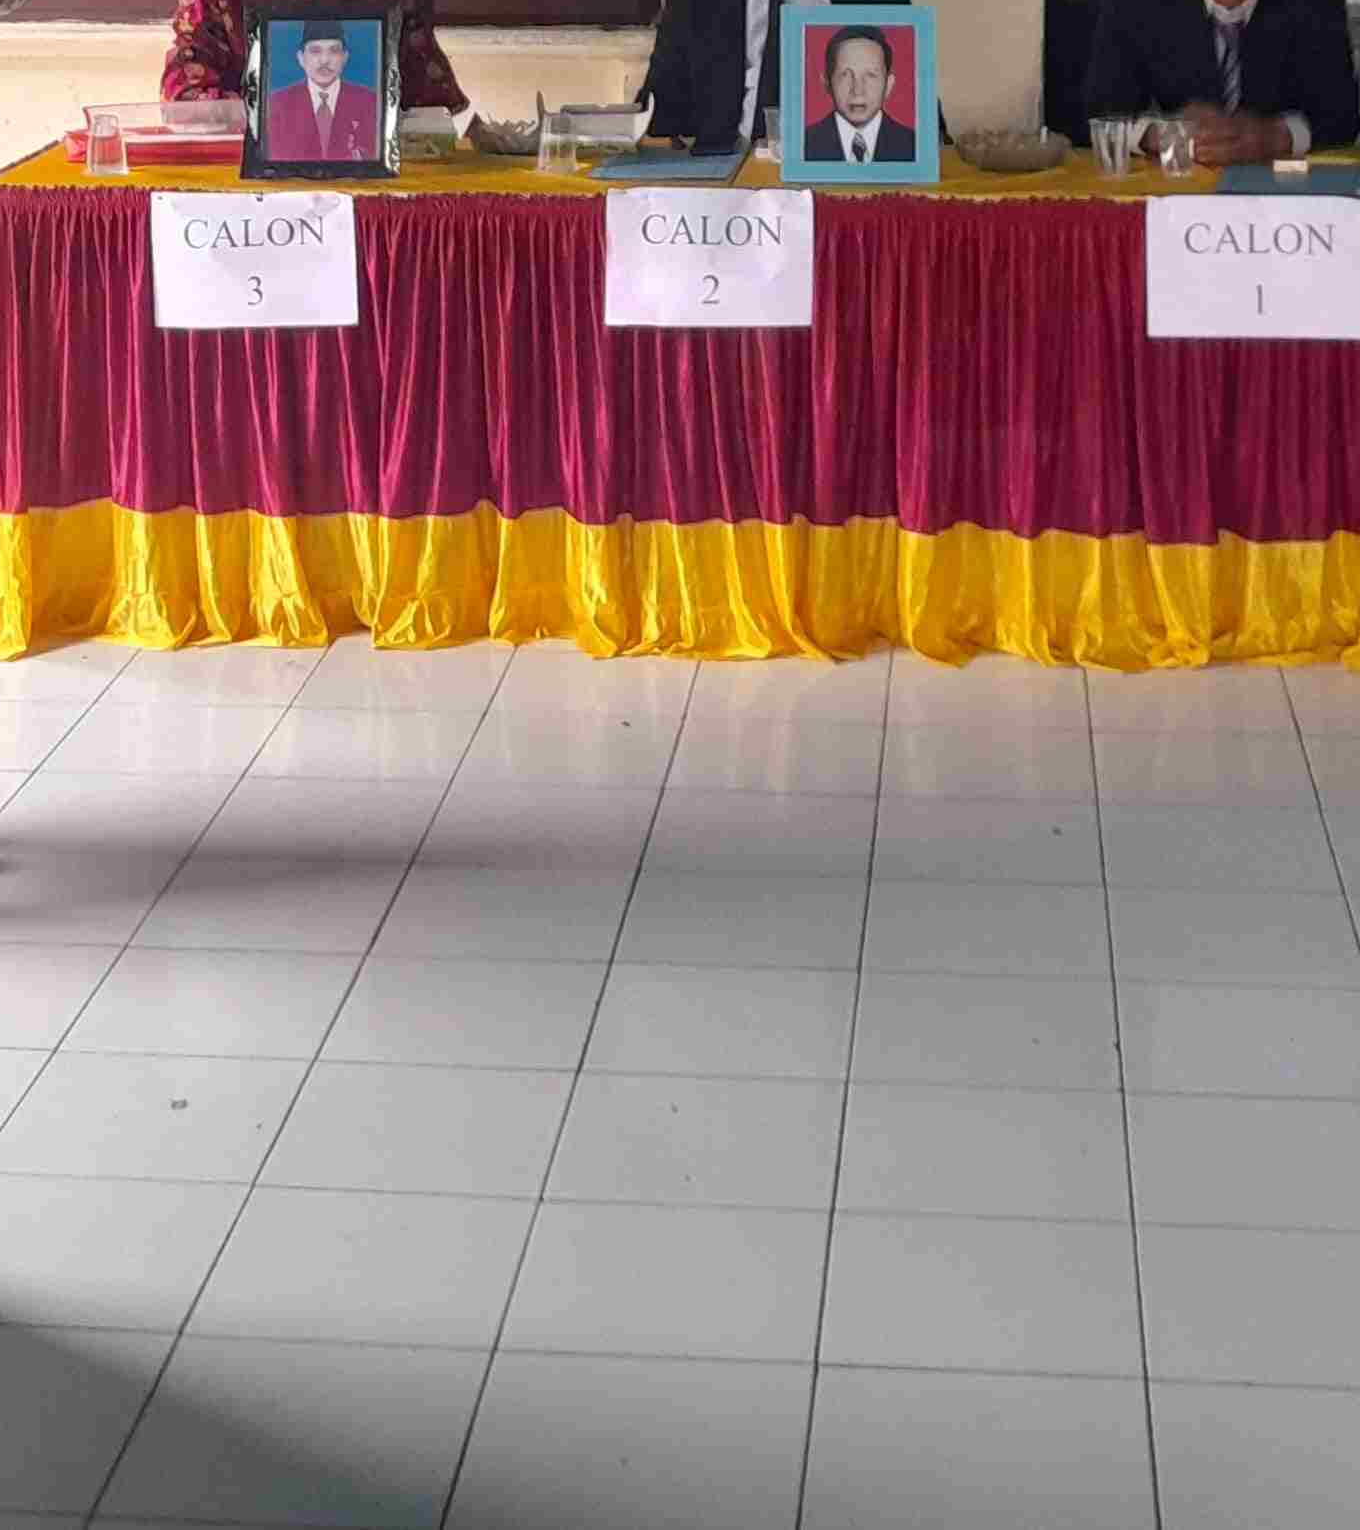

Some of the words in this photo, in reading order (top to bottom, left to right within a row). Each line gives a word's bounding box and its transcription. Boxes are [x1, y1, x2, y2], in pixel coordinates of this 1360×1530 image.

[182, 215, 327, 251] CALON
[640, 214, 783, 248] CALON
[1183, 221, 1337, 256] CALON
[246, 274, 265, 308] 3
[700, 274, 721, 306] 2
[1255, 282, 1265, 316] 1
